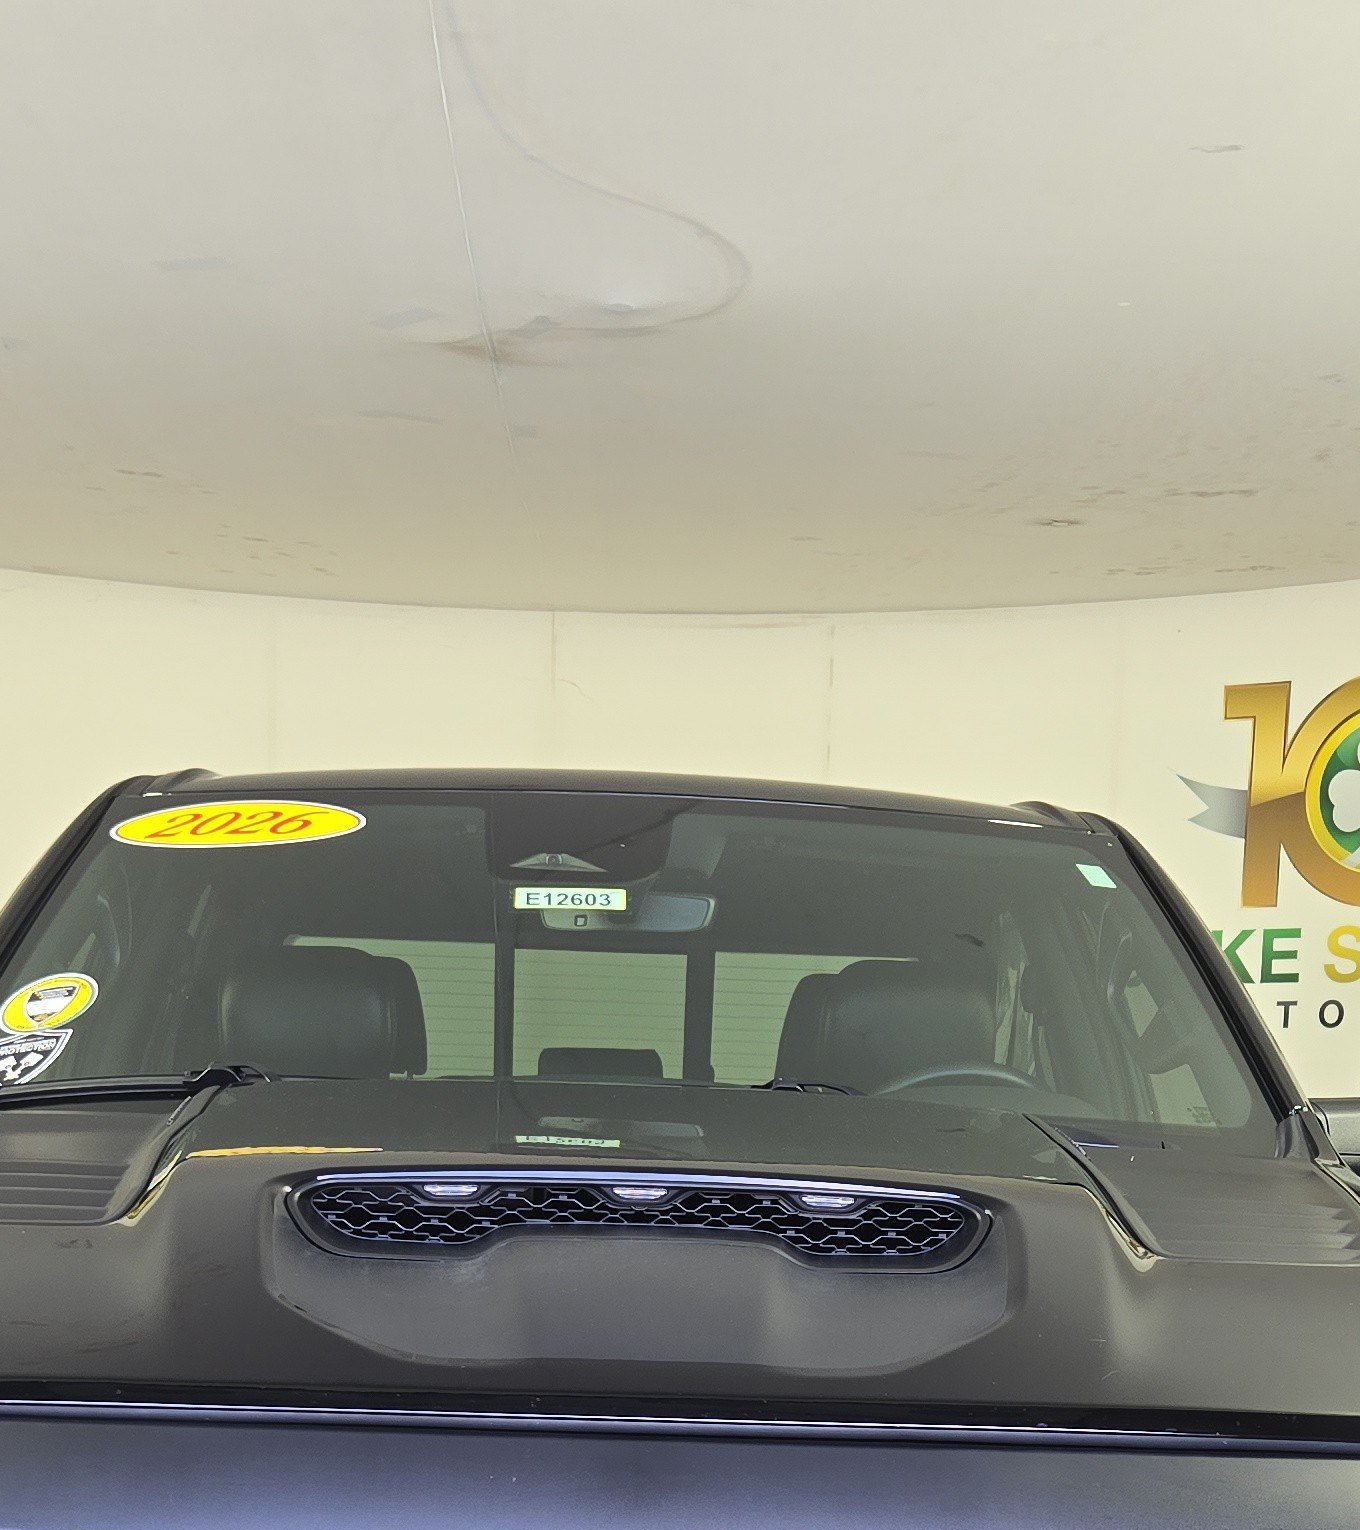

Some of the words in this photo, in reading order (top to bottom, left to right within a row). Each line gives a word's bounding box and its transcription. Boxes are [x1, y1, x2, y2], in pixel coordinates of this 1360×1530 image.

[143, 809, 332, 840] 2026
[525, 891, 612, 907] E12603
[1211, 927, 1302, 984] KE
